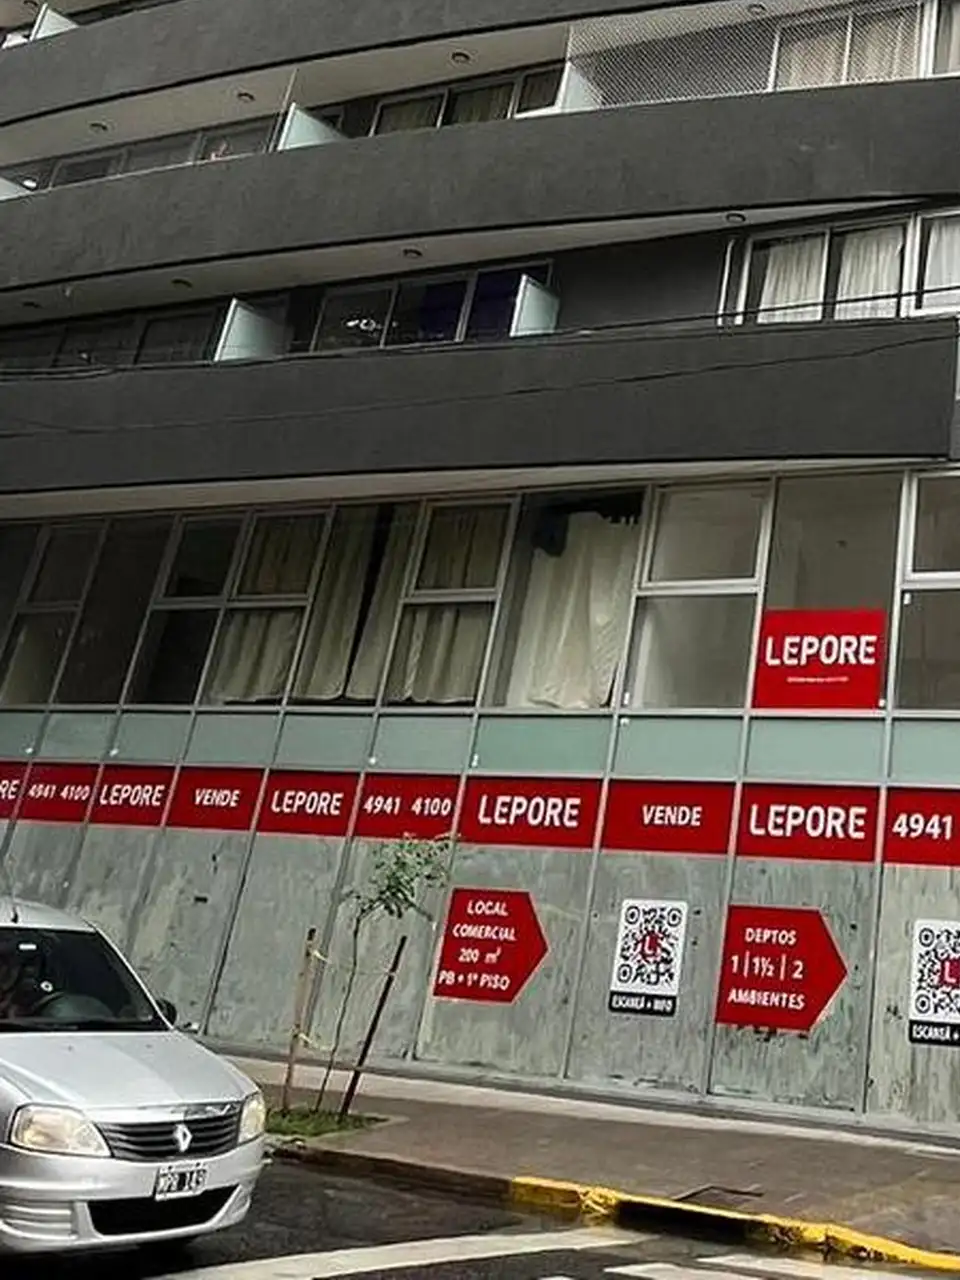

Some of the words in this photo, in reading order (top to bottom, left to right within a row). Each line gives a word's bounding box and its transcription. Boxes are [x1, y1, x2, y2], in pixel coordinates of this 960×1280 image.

[765, 634, 878, 666] LEPORE
[28, 784, 57, 799] 4941
[60, 785, 90, 801] 4100
[100, 784, 165, 806] LEPORE
[194, 788, 240, 807] VENDE
[271, 790, 344, 815] LEPORE
[363, 795, 401, 815] 4941
[412, 797, 452, 817] 4100
[477, 794, 581, 828] LEPORE
[642, 804, 702, 827] VENDE
[749, 803, 867, 839] LEPORE
[892, 813, 952, 840] 4941
[467, 900, 508, 917] LOCAL
[452, 923, 517, 941] COMERCIAL
[744, 927, 797, 945] DEPTOS
[458, 948, 479, 963] 200
[731, 955, 739, 973] 1
[792, 960, 804, 979] 2
[438, 970, 455, 985] PB
[480, 973, 510, 991] PISO
[727, 988, 805, 1010] AMBIENTES
